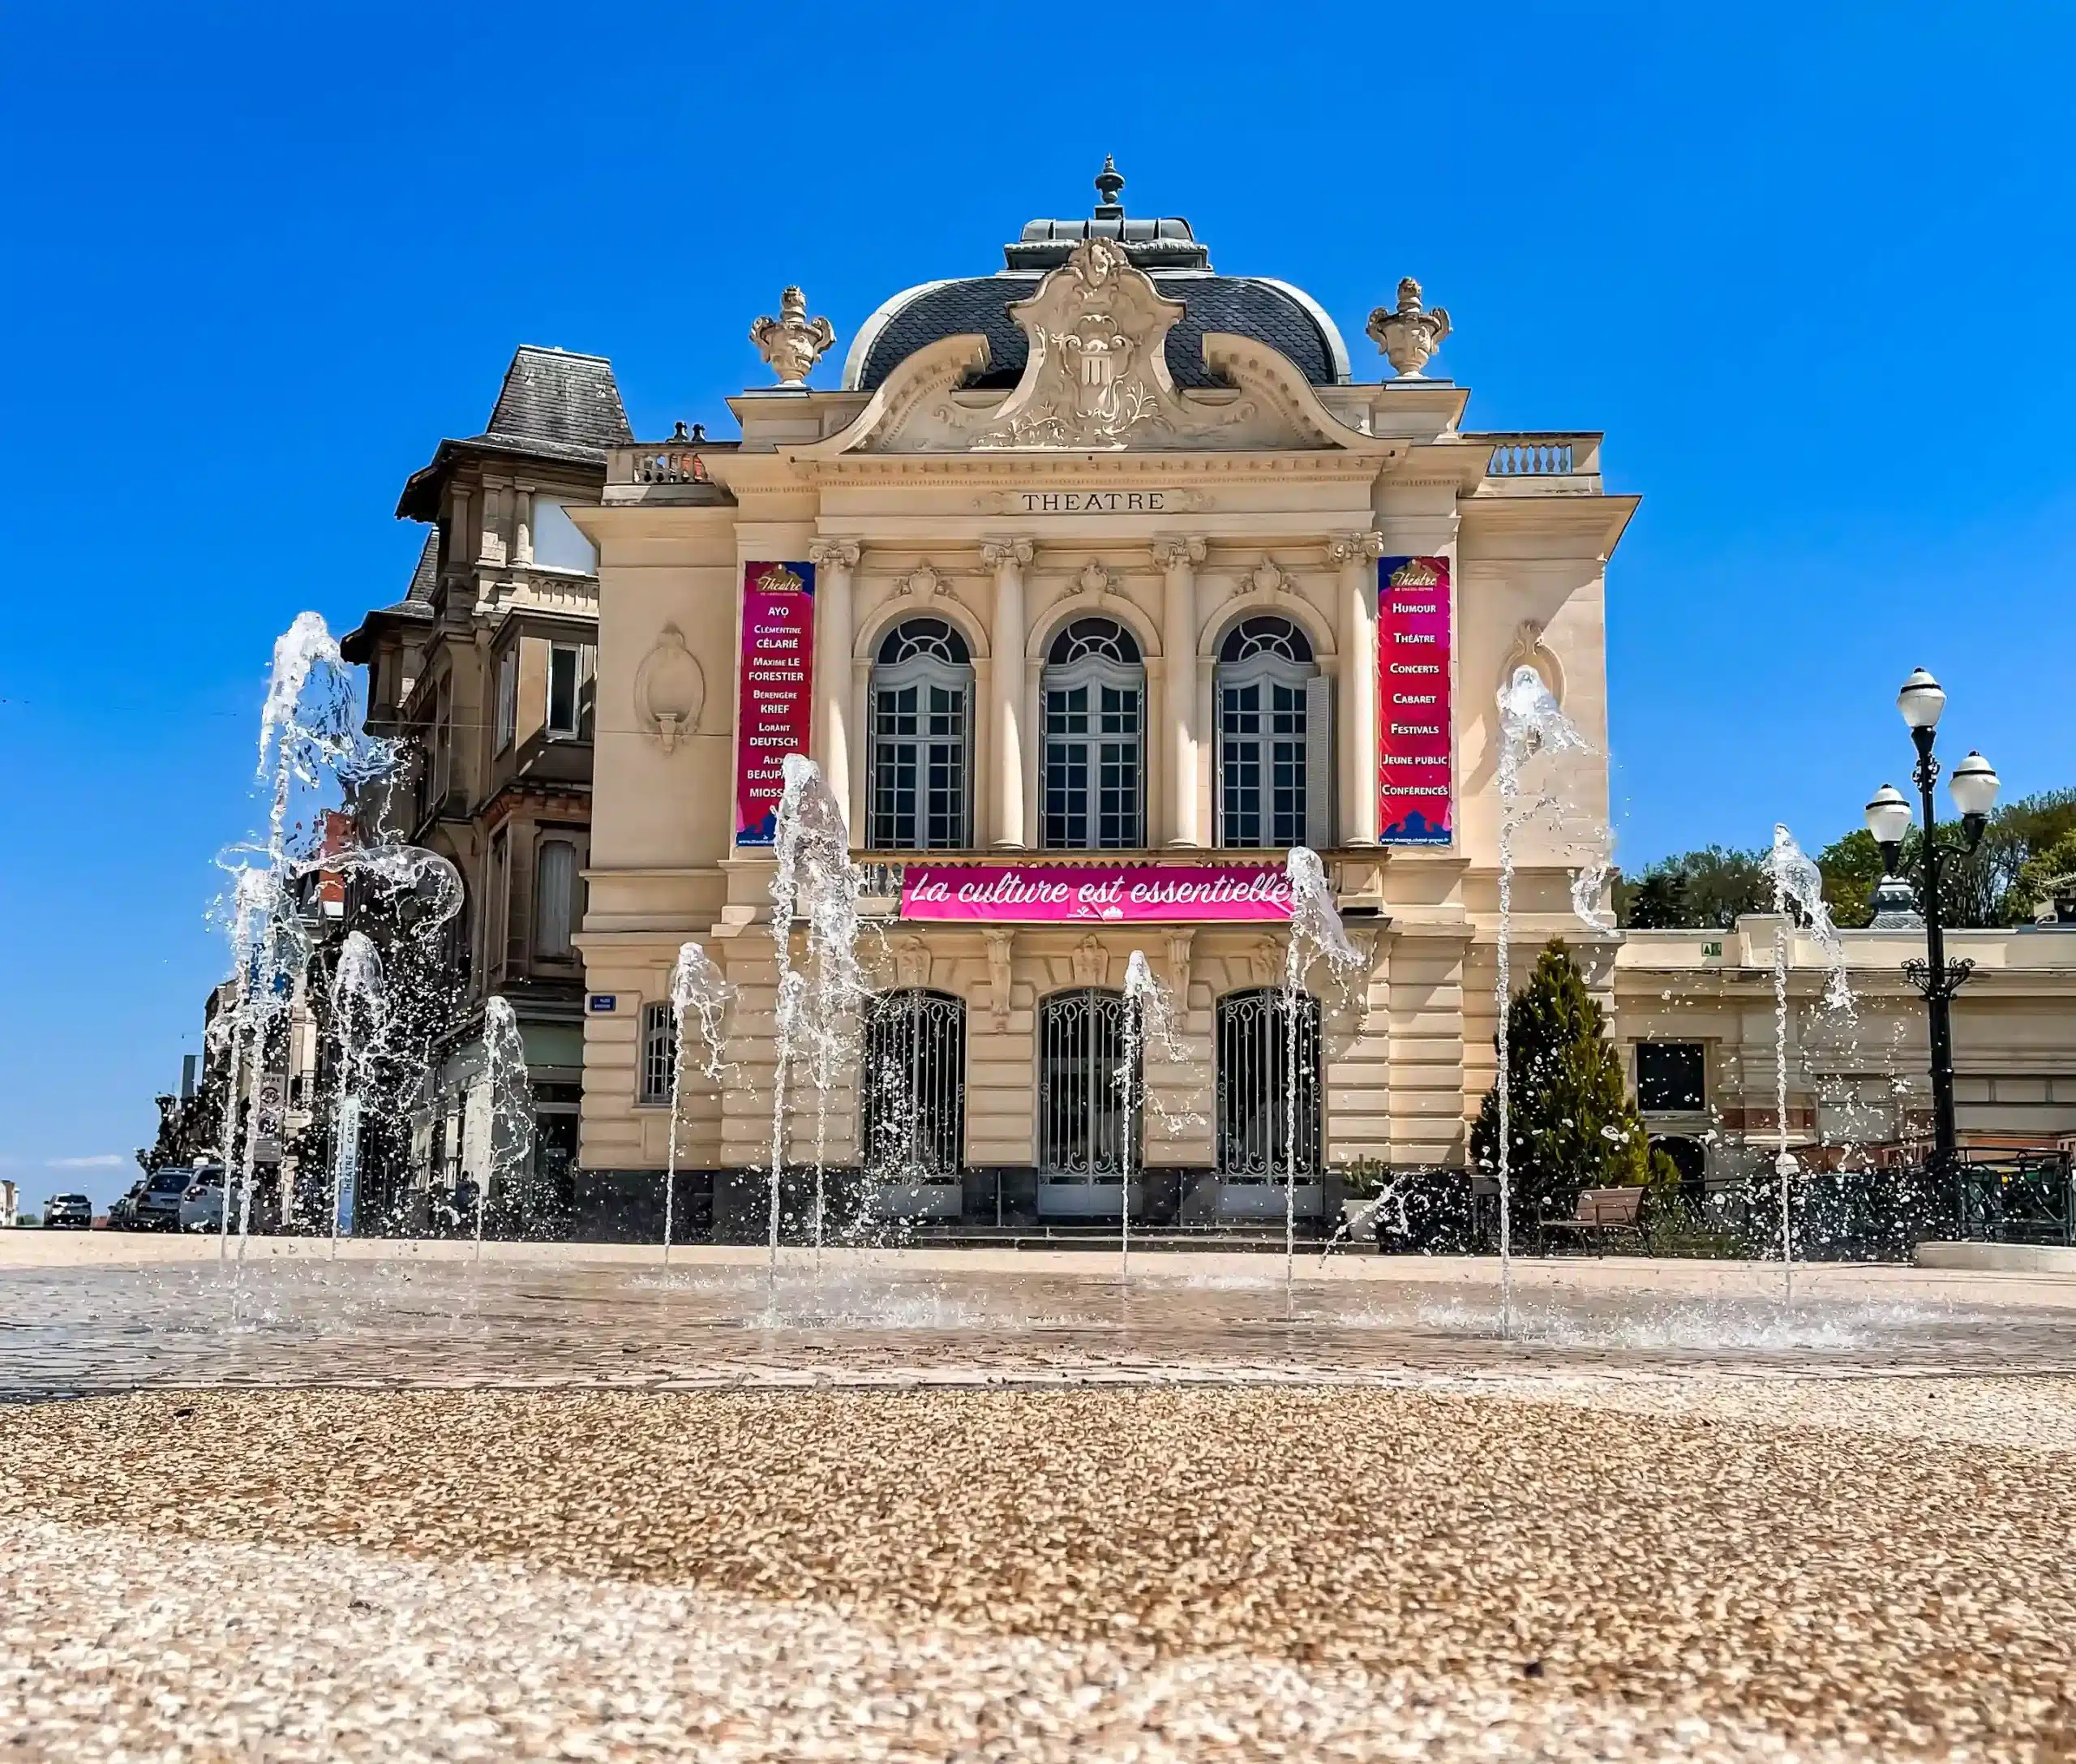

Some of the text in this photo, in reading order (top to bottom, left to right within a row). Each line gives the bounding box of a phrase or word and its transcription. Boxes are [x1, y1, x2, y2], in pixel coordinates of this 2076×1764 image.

[1022, 493, 1165, 511] THEATRE
[756, 637, 799, 649] CÉLARIÉ
[787, 657, 801, 667] LE
[1389, 663, 1439, 674] CONCERTS
[748, 672, 804, 681] FORESTIER
[1392, 693, 1437, 704] CABARET
[760, 704, 791, 714] KRIEF
[1391, 723, 1439, 734] FESTIVALS
[749, 736, 799, 747] DEUTSCH
[1382, 753, 1413, 765] JEUNE
[747, 770, 783, 779] BEAUP
[749, 788, 783, 797] MIOSS
[909, 871, 1292, 904] La culture est essentielle
